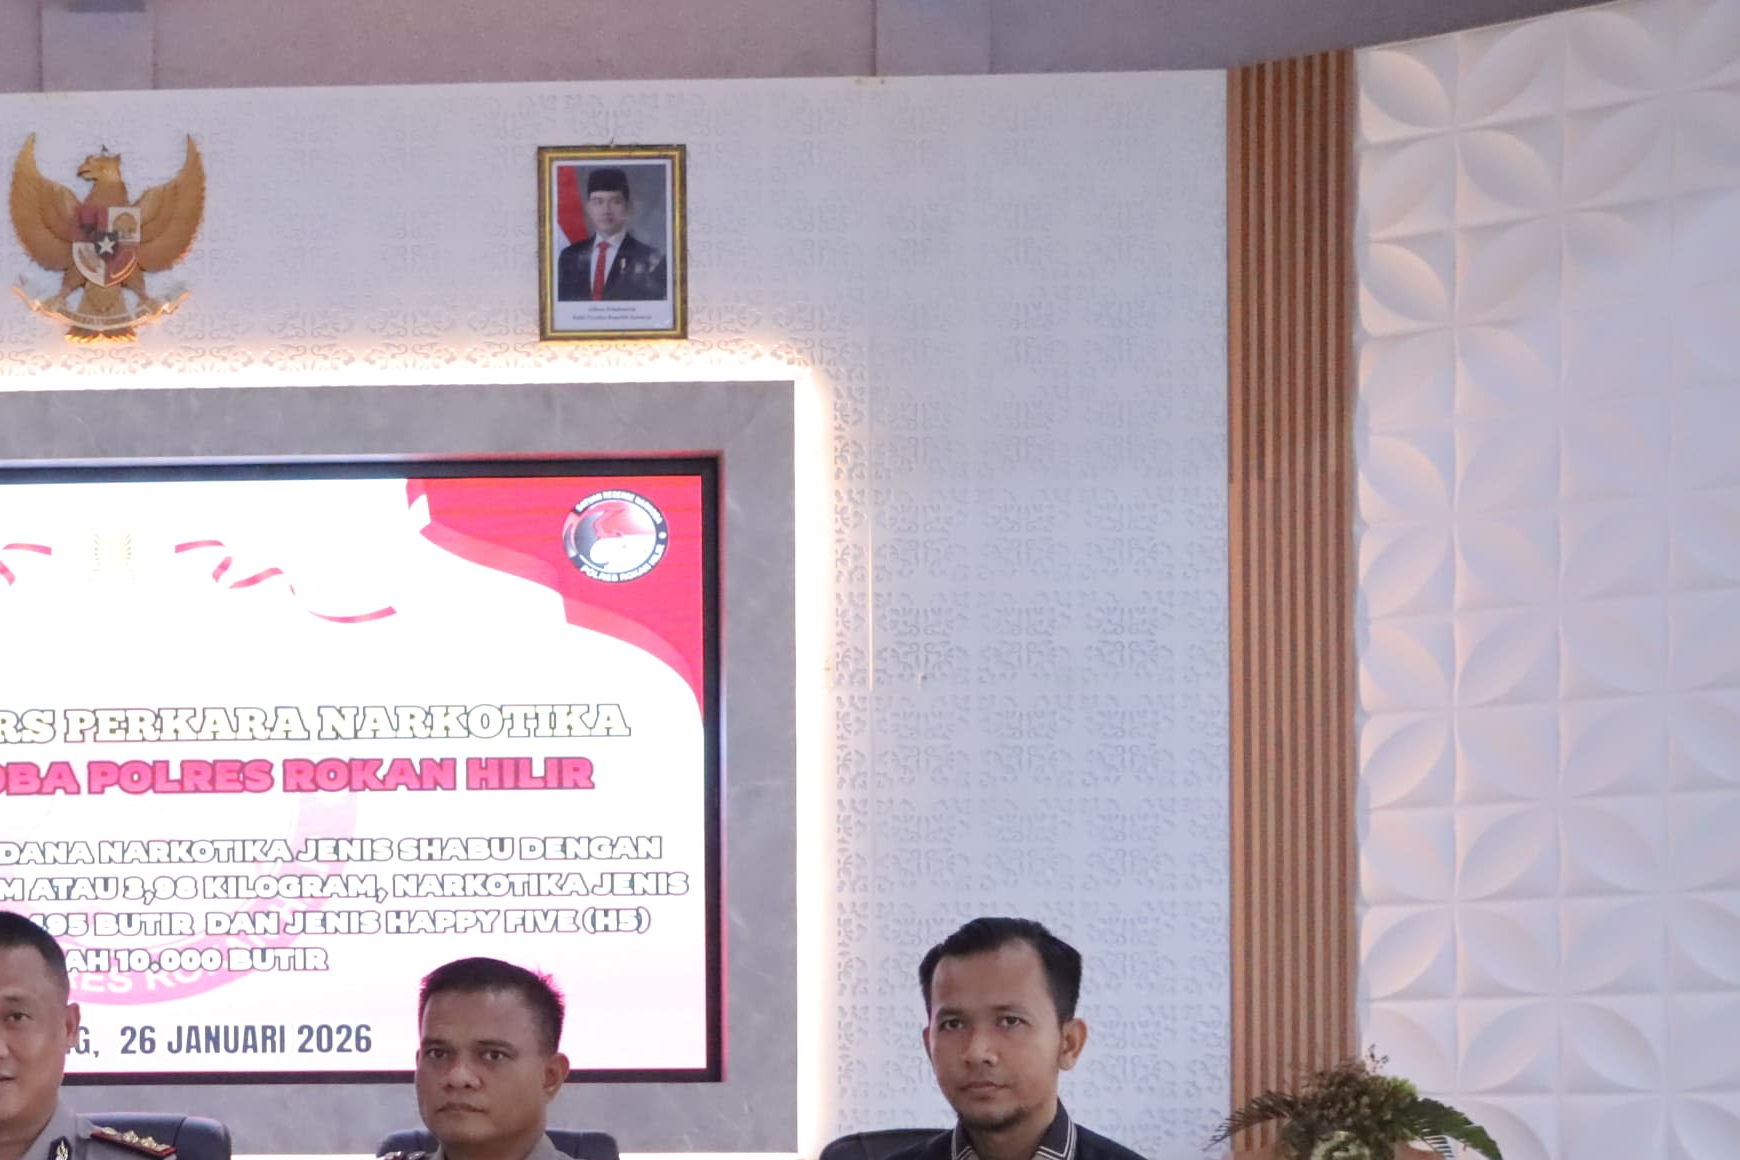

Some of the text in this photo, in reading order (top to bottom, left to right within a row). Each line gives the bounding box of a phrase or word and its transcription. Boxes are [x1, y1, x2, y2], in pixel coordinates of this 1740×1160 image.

[64, 707, 311, 743] PERKARA
[318, 704, 632, 740] NARKOTIKA
[87, 759, 275, 795] POLRES
[283, 757, 458, 793] ROKAN
[466, 757, 595, 790] HILIR
[99, 839, 294, 864] NARKOTIKA
[296, 838, 394, 863] JENIS
[397, 837, 515, 862] SHABU
[519, 836, 663, 861] DENGAN
[29, 876, 119, 902] ATAU
[123, 876, 198, 906] 3,98
[203, 874, 388, 904] KILOGRAM,
[392, 872, 590, 899] NARKOTIKA
[591, 872, 690, 897] JENIS
[94, 912, 194, 937] BUTIR
[205, 911, 280, 936] DAN
[284, 910, 381, 935] JENIS
[385, 909, 501, 935] HAPPY
[504, 908, 579, 934] FIVE
[582, 906, 652, 934] (H5)
[115, 948, 223, 973] 10.000
[228, 947, 330, 972] BUTIR
[120, 1025, 157, 1054] 26
[167, 1024, 286, 1054] JANUARI
[296, 1024, 373, 1053] 2026
